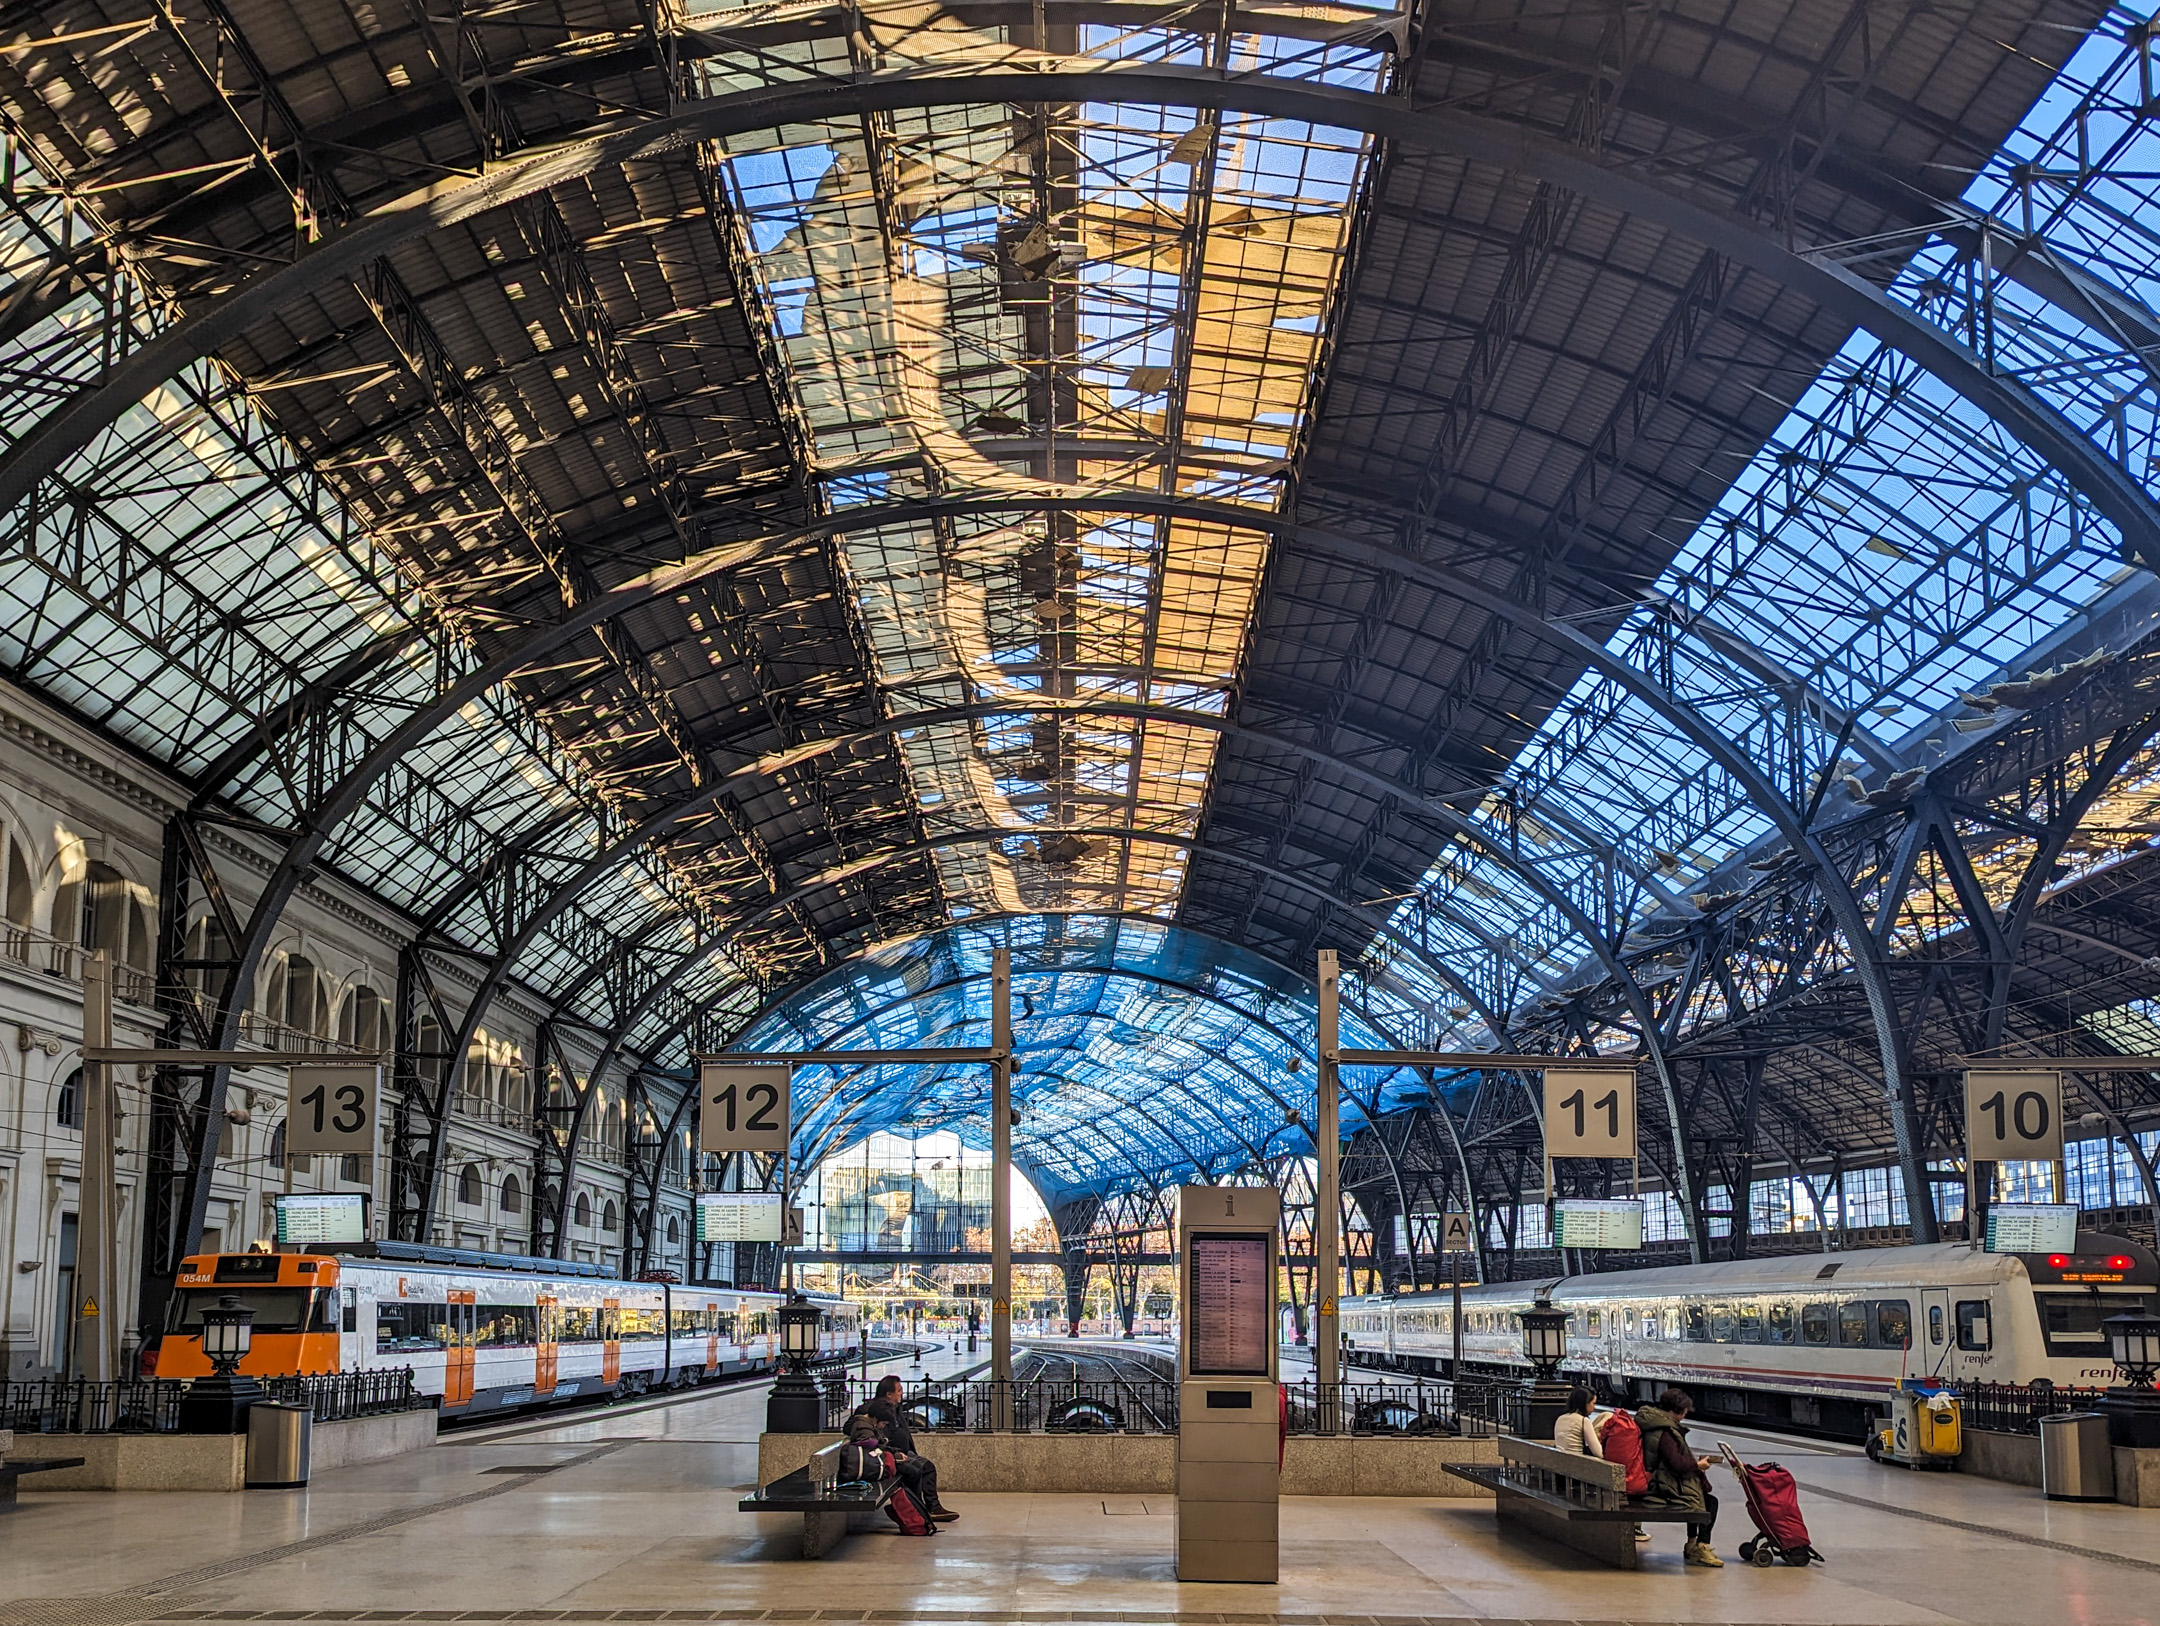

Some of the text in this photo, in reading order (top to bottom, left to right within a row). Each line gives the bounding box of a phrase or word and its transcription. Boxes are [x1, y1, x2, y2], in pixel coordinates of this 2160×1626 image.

[301, 1085, 366, 1133] 13
[712, 1084, 779, 1132] 12
[1560, 1089, 1618, 1138] 11
[1980, 1091, 2049, 1140] 10
[1448, 1217, 1465, 1237] A
[183, 1274, 210, 1283] 054M
[955, 1285, 966, 1294] 13
[980, 1286, 991, 1295] 12
[1965, 1352, 1992, 1368] renfe
[2080, 1365, 2127, 1384] renfe
